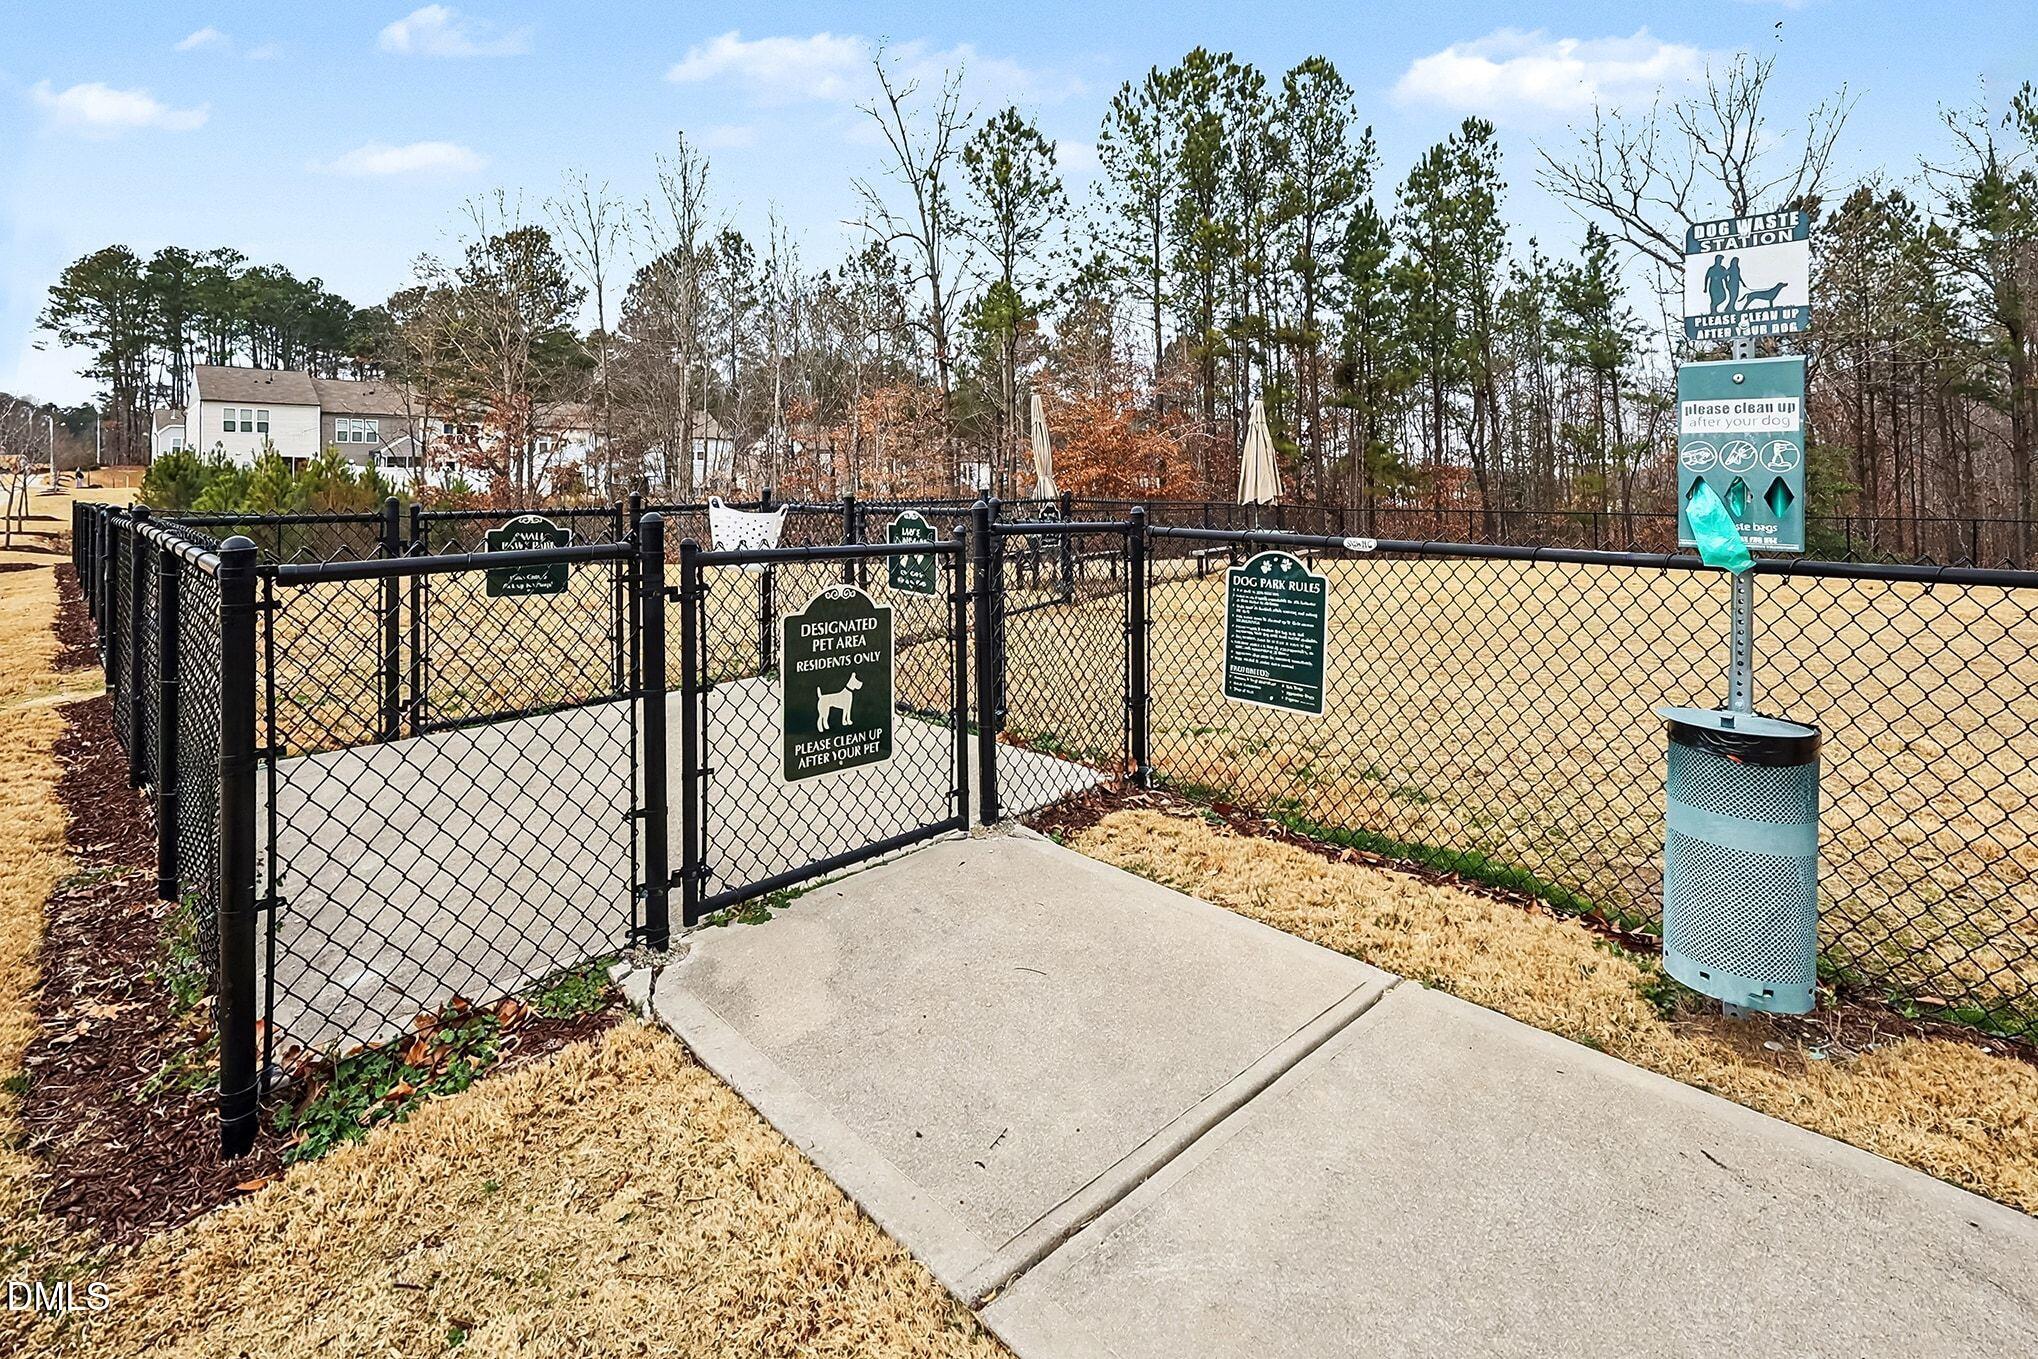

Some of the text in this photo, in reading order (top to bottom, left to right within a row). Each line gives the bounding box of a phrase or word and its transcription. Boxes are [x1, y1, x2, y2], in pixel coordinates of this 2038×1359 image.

[1694, 211, 1799, 240] DOG WASTE
[1700, 230, 1793, 253] STATION
[1694, 309, 1799, 327] PLEASE CLEAN UP
[1696, 327, 1732, 340] AFTER
[1771, 322, 1798, 333] DOG
[1685, 402, 1796, 416] please clean up
[1689, 415, 1791, 429] after your dog
[1753, 522, 1778, 534] bags
[1233, 576, 1257, 587] DOG
[1260, 578, 1285, 590] PARK
[1289, 581, 1320, 593] RULES
[801, 618, 878, 637] DESIGNATED
[812, 634, 866, 652] PET AREA
[796, 651, 881, 672] RESIDENTS ONLY
[795, 728, 883, 756] PLEASE CLEAN UP
[798, 741, 880, 770] AFTER YOUR PET
